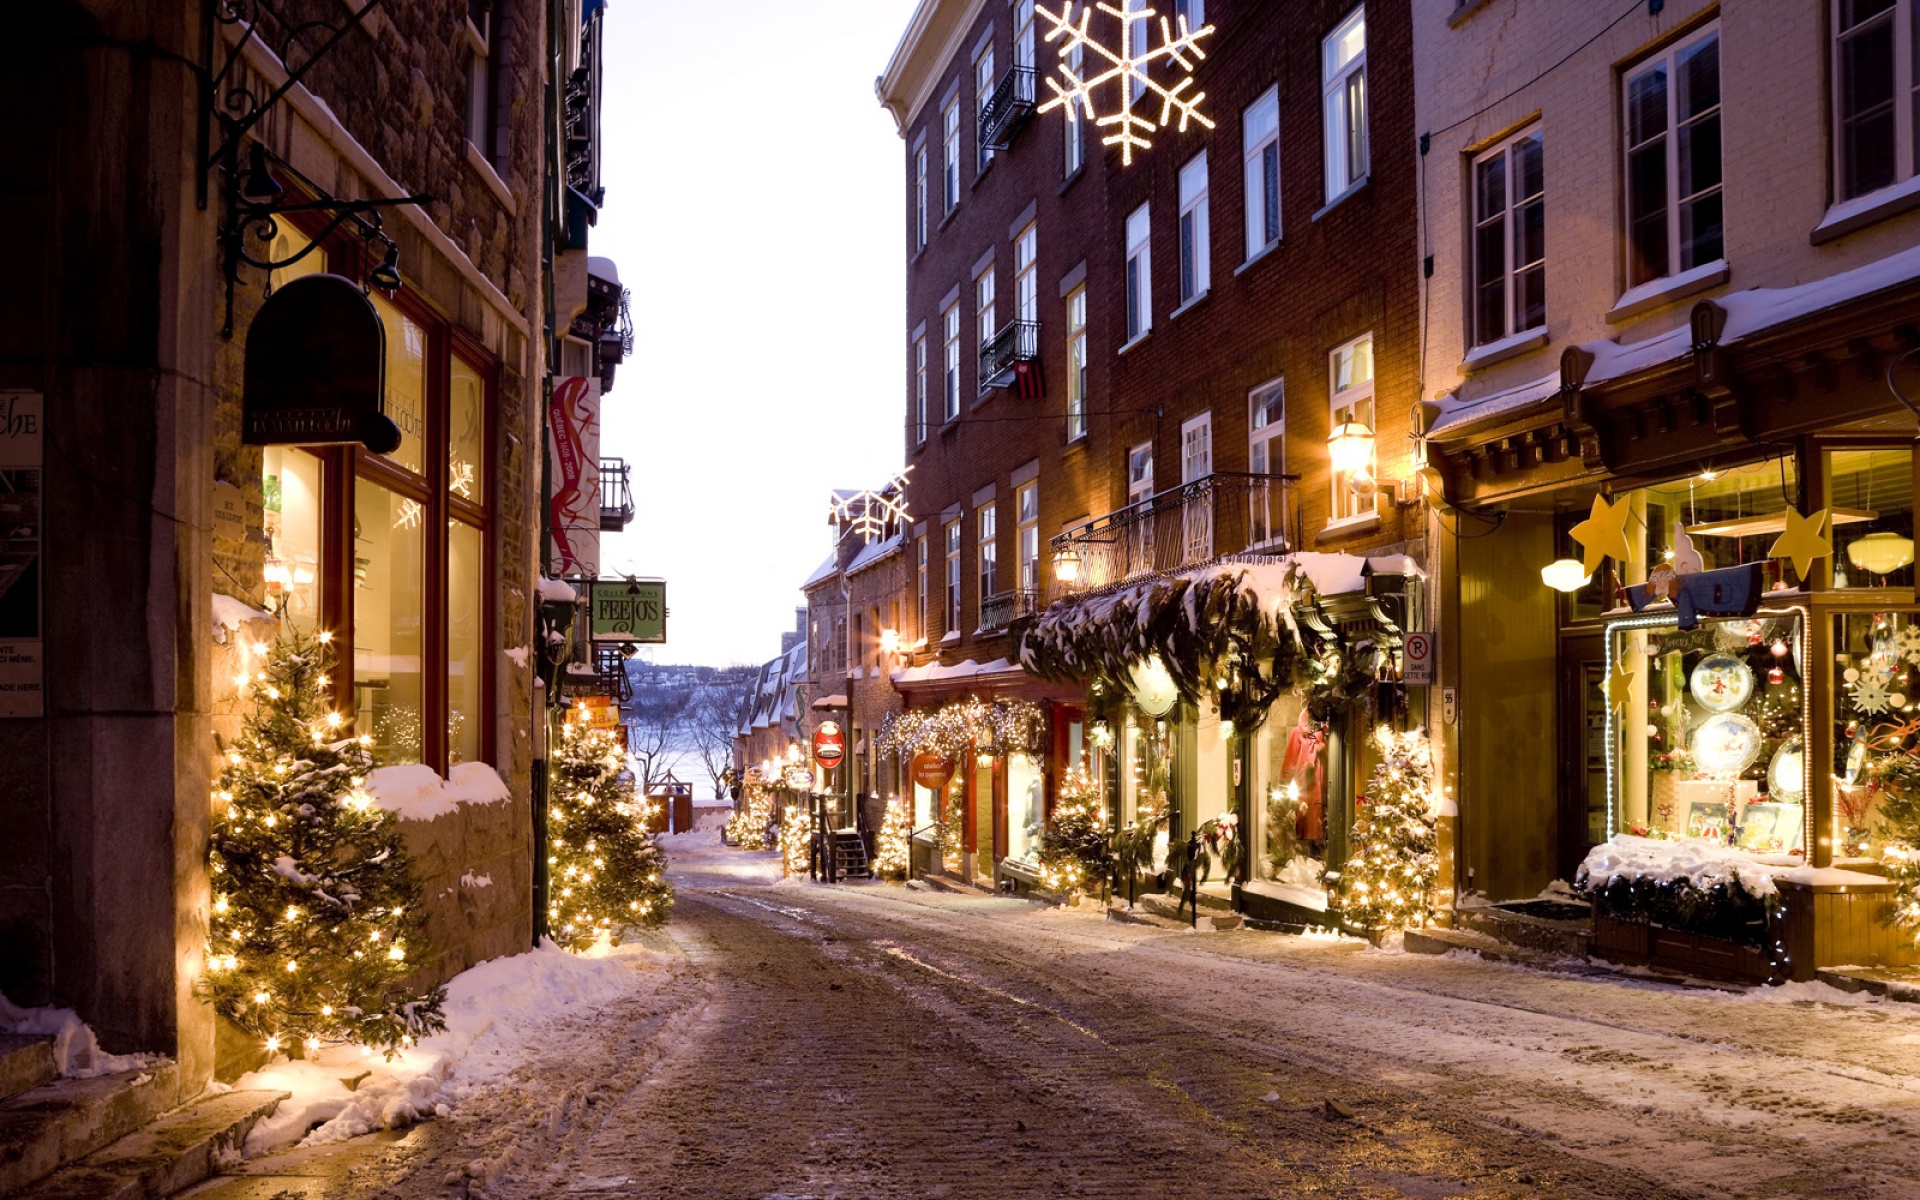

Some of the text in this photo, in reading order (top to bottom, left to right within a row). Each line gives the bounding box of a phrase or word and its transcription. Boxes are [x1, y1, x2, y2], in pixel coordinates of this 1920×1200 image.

[552, 408, 566, 440] QUÉBEC
[597, 589, 658, 598] COLLEONS
[1410, 664, 1425, 672] DANS
[1404, 671, 1419, 679] CETTE
